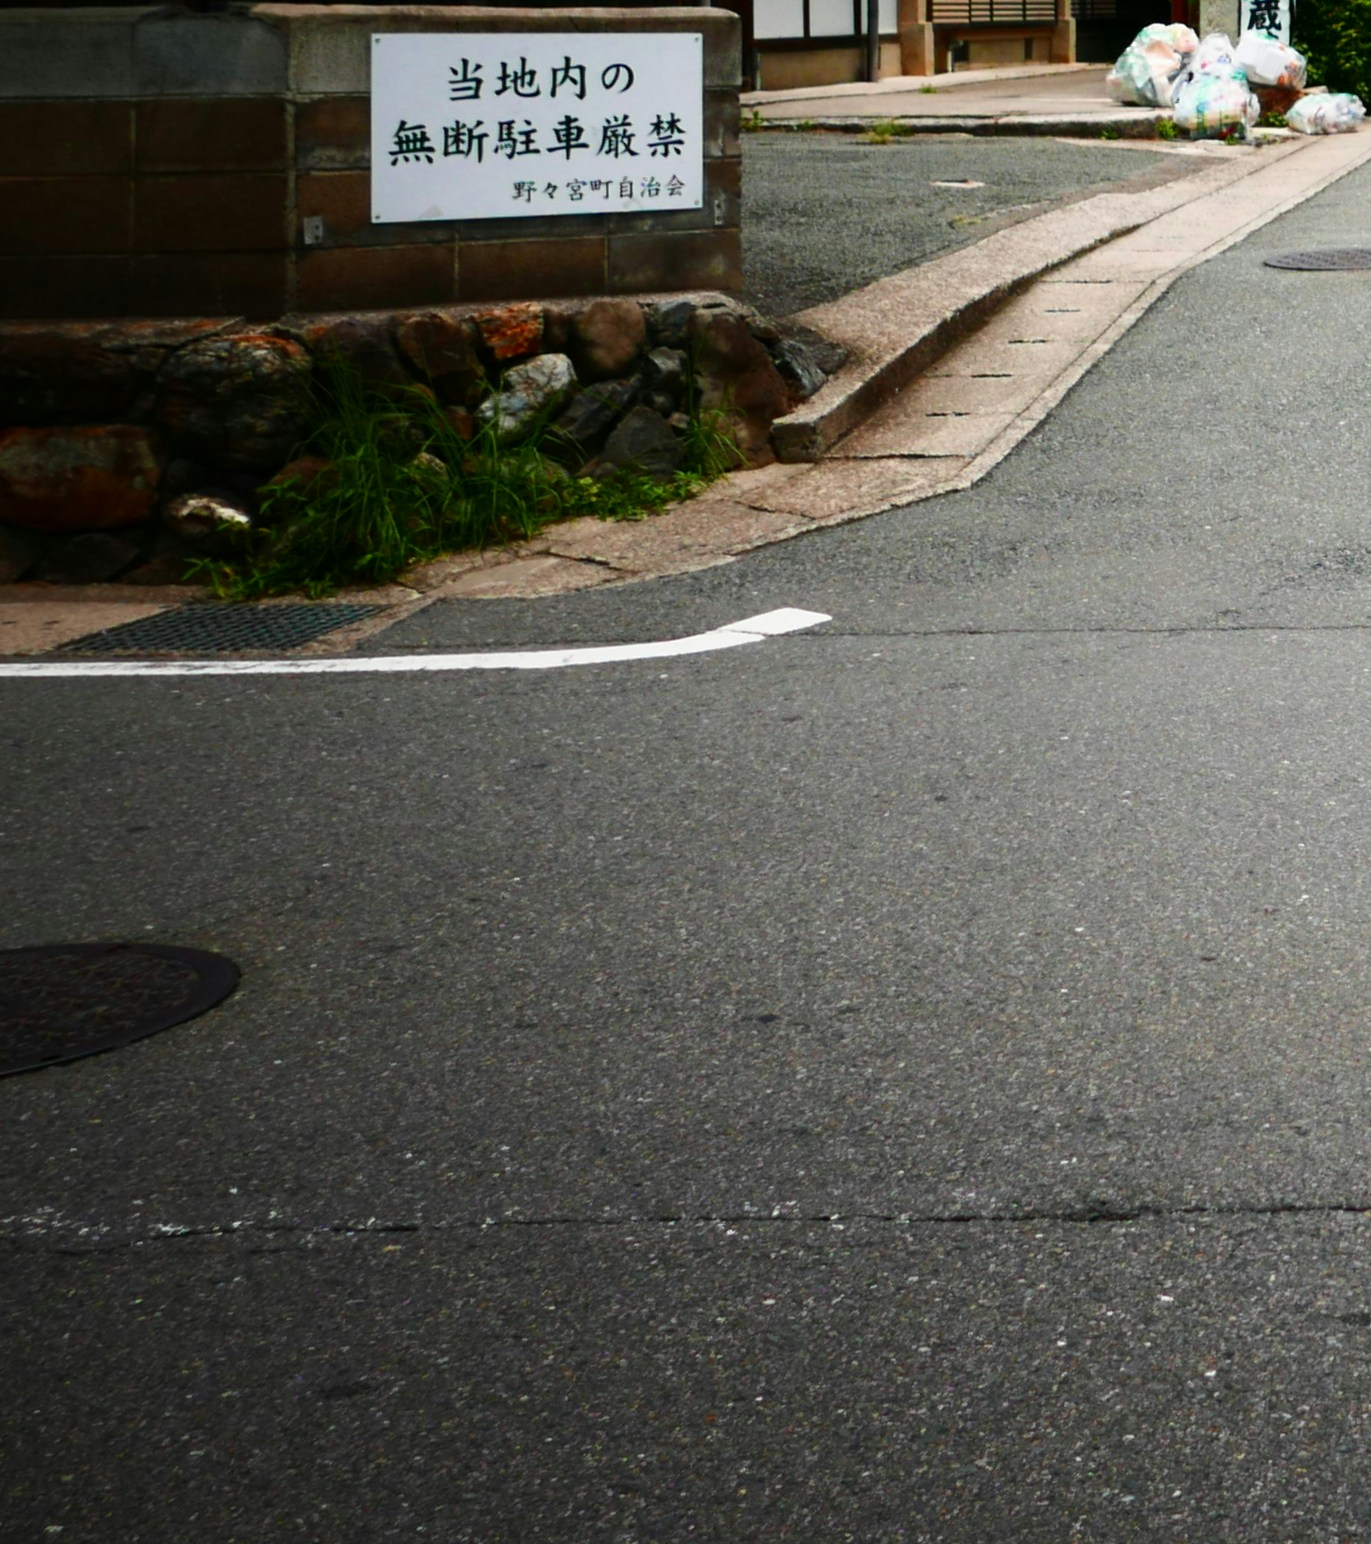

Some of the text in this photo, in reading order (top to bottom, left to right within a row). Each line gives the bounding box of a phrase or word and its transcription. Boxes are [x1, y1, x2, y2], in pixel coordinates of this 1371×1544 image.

[447, 55, 636, 102] 当地内の
[387, 111, 688, 167] 無断駐車厳禁
[511, 174, 686, 204] 野々宮町自治会
